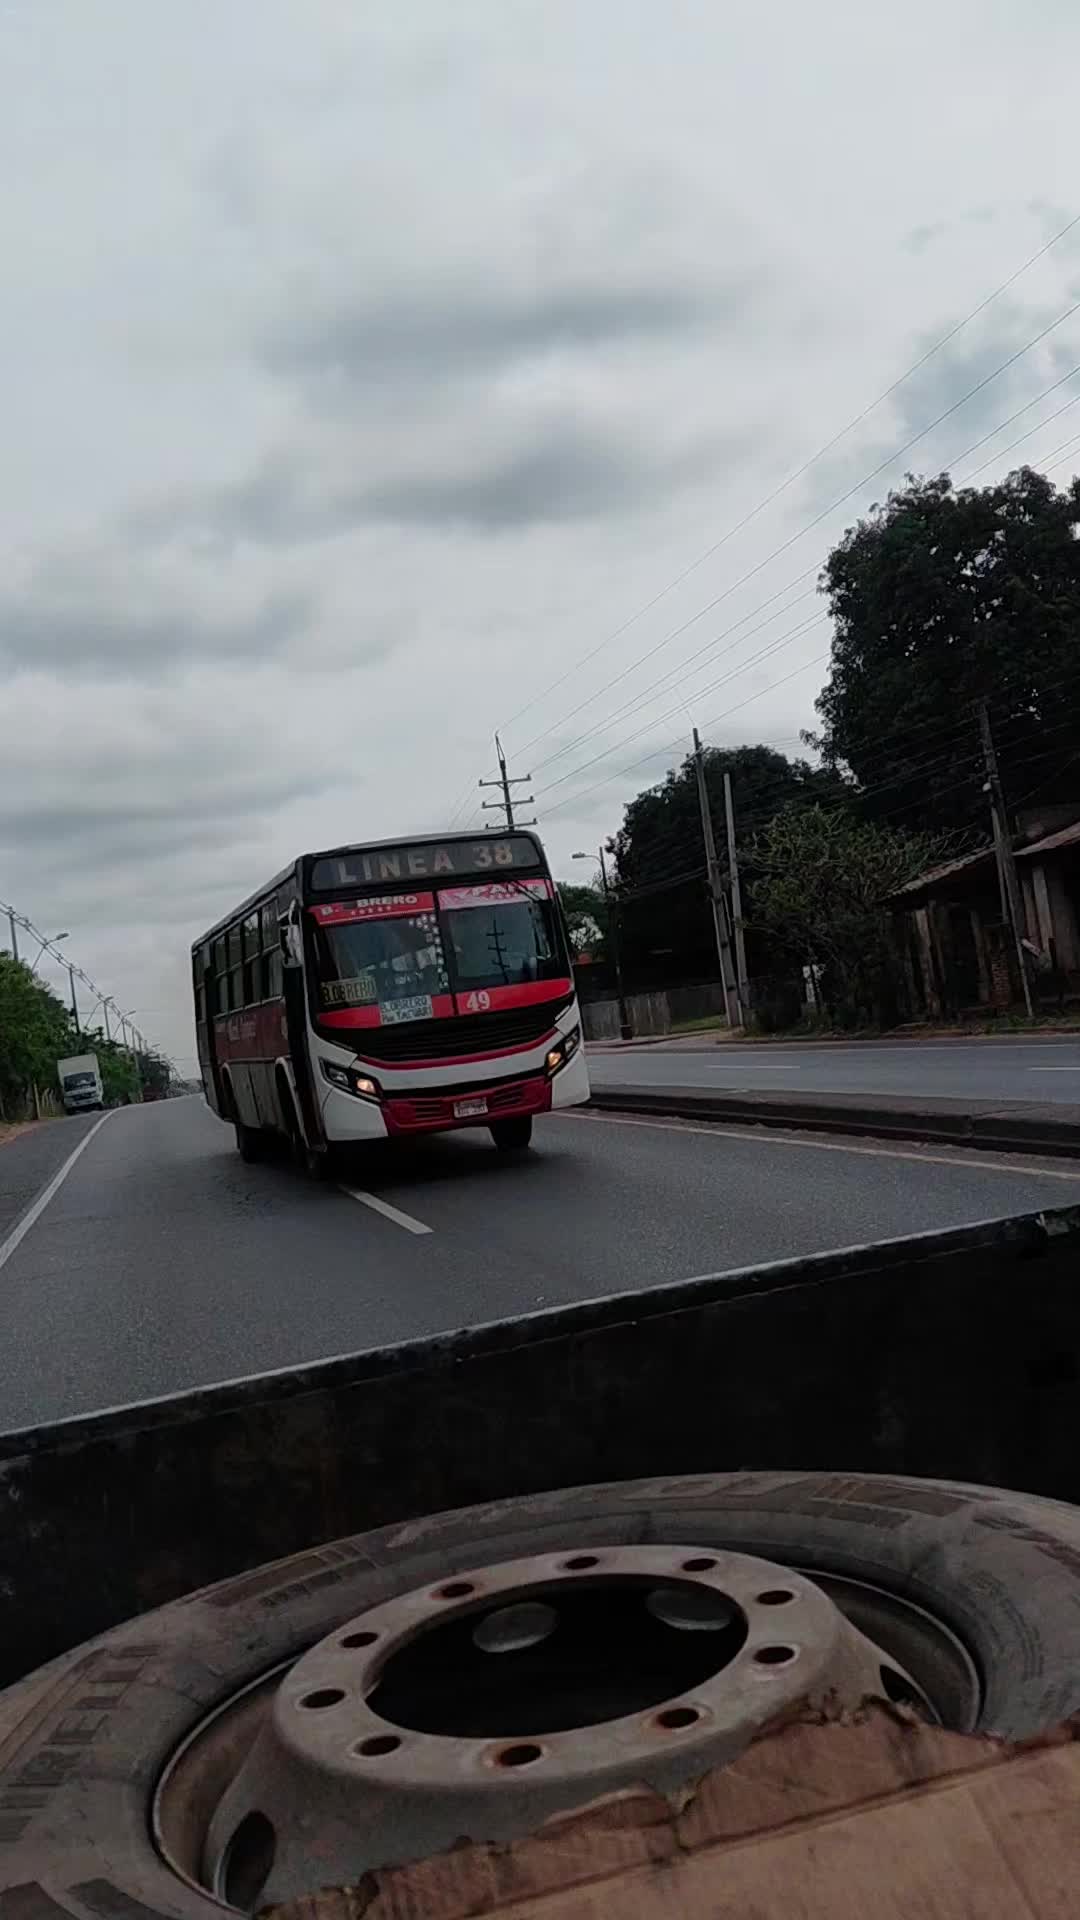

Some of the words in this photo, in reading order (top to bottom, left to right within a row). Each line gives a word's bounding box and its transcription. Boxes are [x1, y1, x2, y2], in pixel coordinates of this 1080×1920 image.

[339, 849, 454, 883] LINEA
[475, 843, 513, 868] 38
[344, 894, 418, 908] BRERO
[466, 991, 490, 1012] 49
